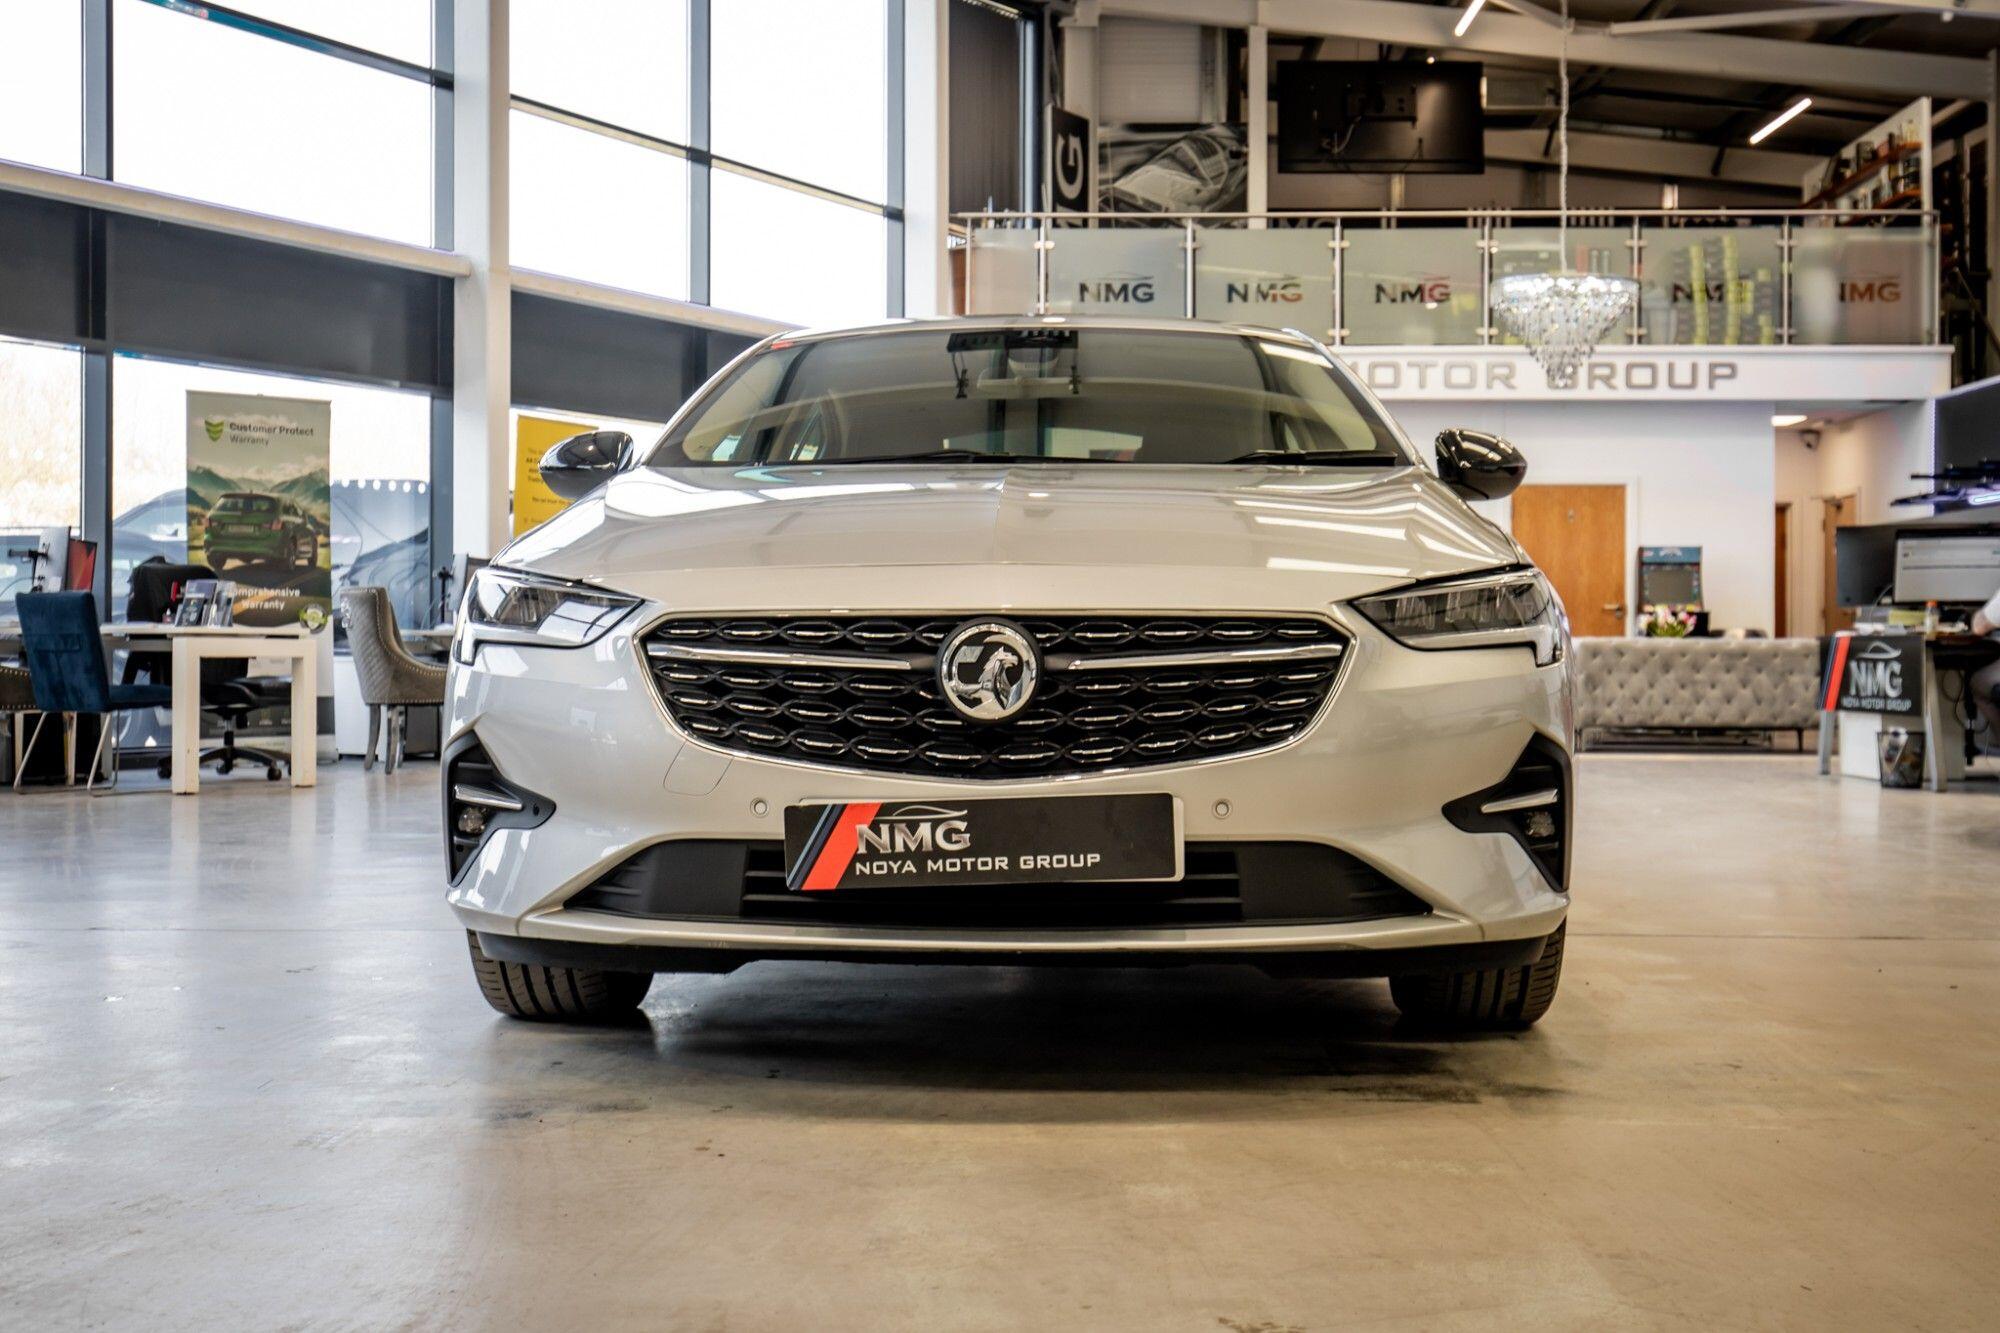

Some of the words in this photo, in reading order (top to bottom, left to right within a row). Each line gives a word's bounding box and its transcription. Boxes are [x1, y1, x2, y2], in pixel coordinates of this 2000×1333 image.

[1079, 282, 1154, 304] NMG
[1227, 282, 1302, 304] NMG
[1375, 282, 1452, 304] NMG
[1672, 282, 1746, 304] NM
[1837, 281, 1901, 304] MG
[1349, 360, 1517, 390] OTOR
[229, 422, 277, 434] Customer
[279, 426, 314, 437] Protect
[229, 434, 270, 446] Warranty
[230, 586, 300, 598] omprehensive
[1849, 660, 1903, 698] NMG
[855, 820, 971, 855] NMG
[855, 860, 917, 875] NOYA
[927, 855, 1010, 872] MOTOR
[1019, 852, 1101, 869] GROUP
